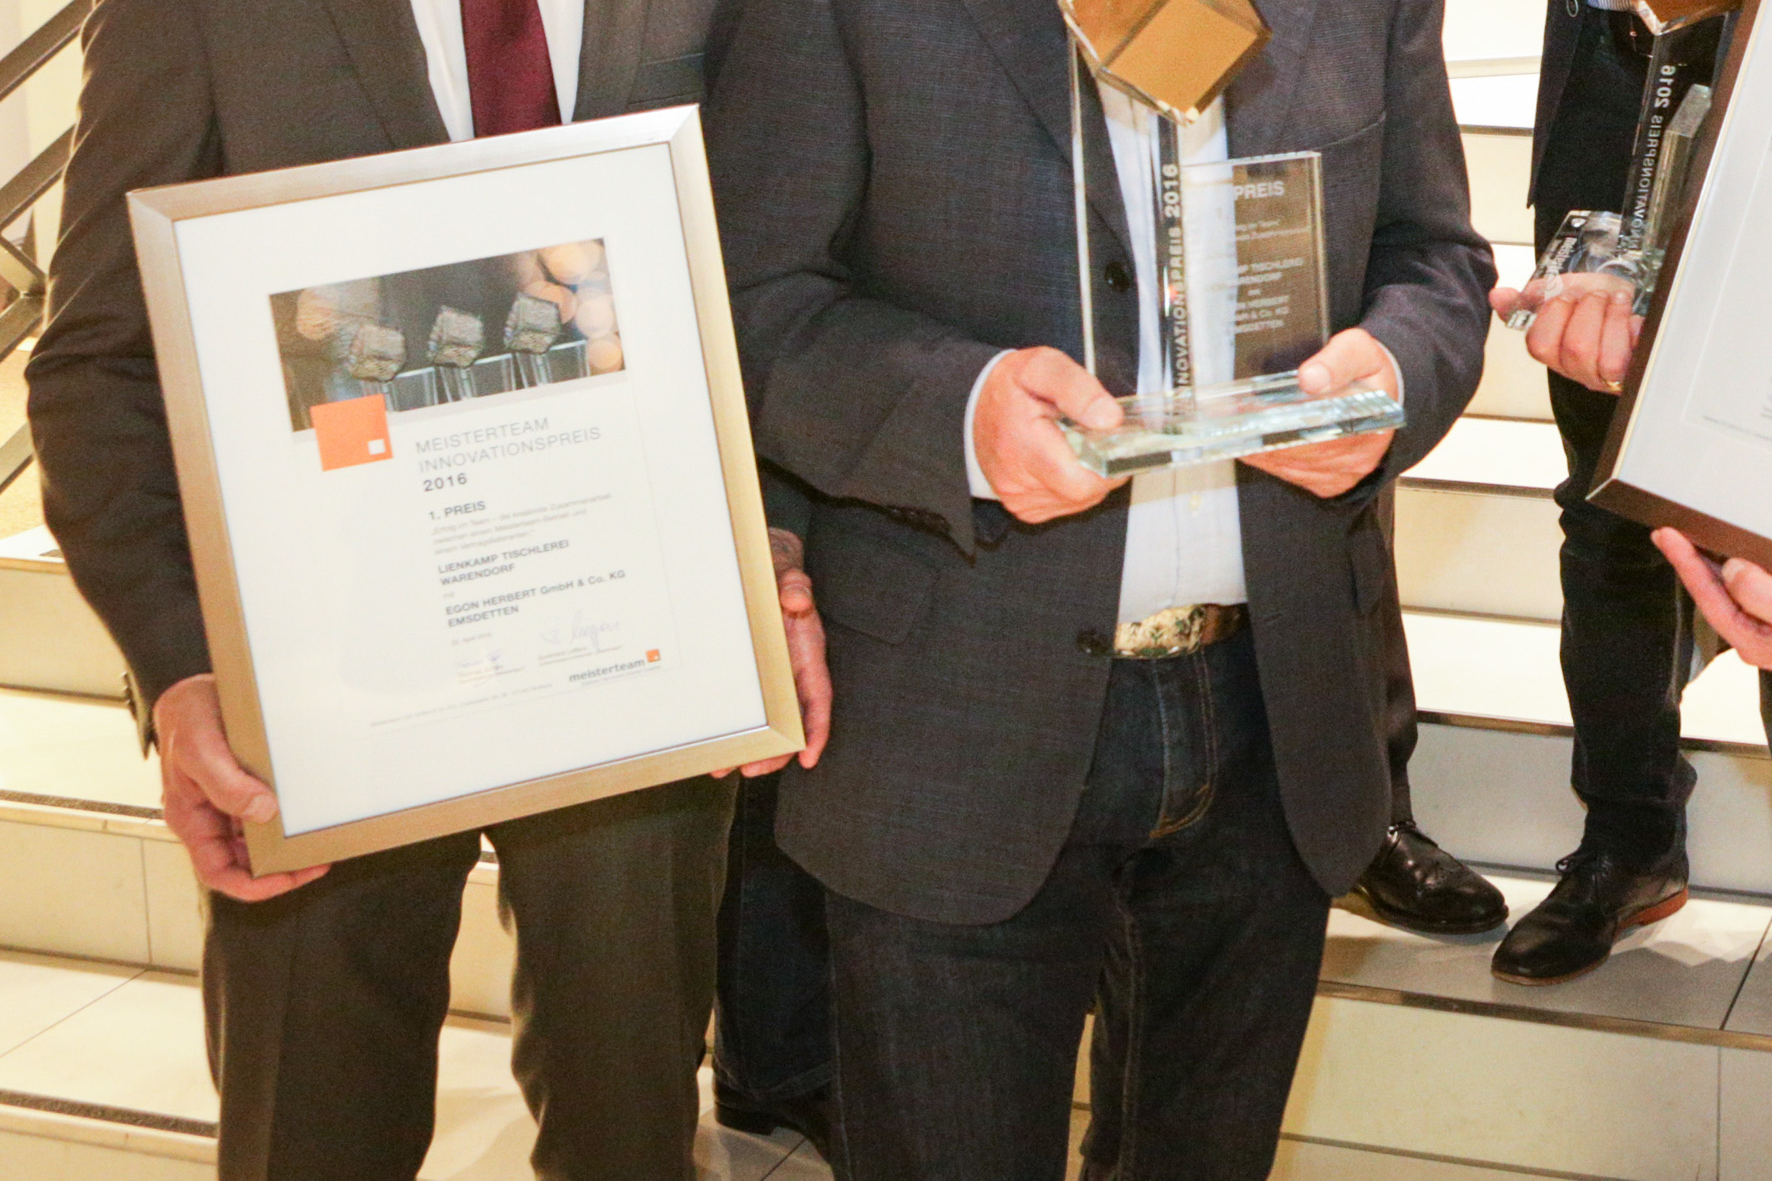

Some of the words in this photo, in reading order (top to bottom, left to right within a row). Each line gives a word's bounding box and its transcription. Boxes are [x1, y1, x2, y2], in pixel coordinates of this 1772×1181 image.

[1162, 163, 1182, 219] 2016
[1232, 180, 1285, 202] PREIS
[415, 417, 551, 455] MEISTERTEAM
[419, 426, 602, 474] INNOVATIONSPREIS
[422, 472, 468, 492] 2016
[429, 511, 441, 522] 1.
[444, 500, 487, 519] PREIS
[437, 553, 499, 574] LIENKAMP
[502, 539, 570, 561] TISCHLEREI
[440, 562, 516, 586] WARENDORF
[445, 600, 480, 616] EGON
[482, 587, 537, 608] HERBERT
[539, 579, 575, 596] GmbH
[577, 578, 585, 588] &
[587, 575, 606, 586] Co.
[609, 569, 626, 581] KG
[447, 604, 520, 628] EMSDETTEN
[568, 658, 645, 683] meisterteam
